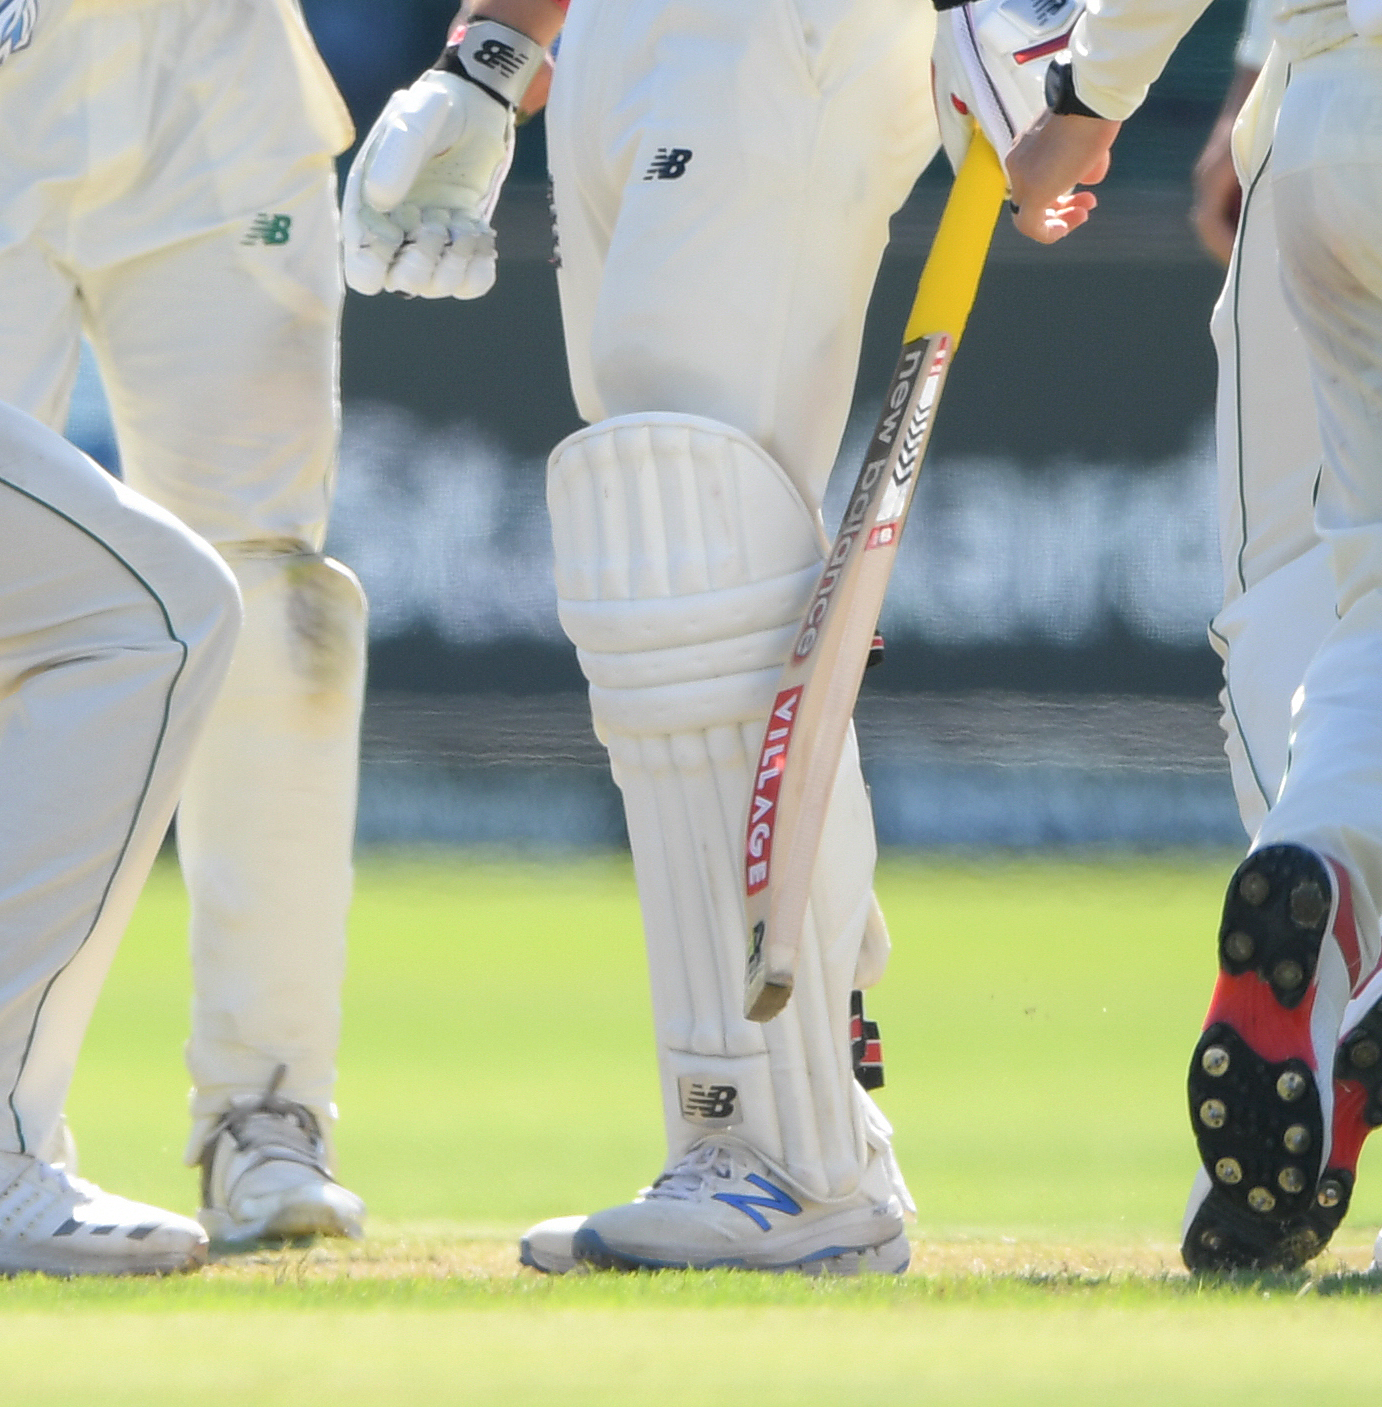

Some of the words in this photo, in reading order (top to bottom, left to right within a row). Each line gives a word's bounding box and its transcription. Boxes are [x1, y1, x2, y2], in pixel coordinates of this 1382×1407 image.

[878, 350, 922, 445] new
[796, 457, 890, 658] balance
[747, 694, 799, 887] VILLAGE
